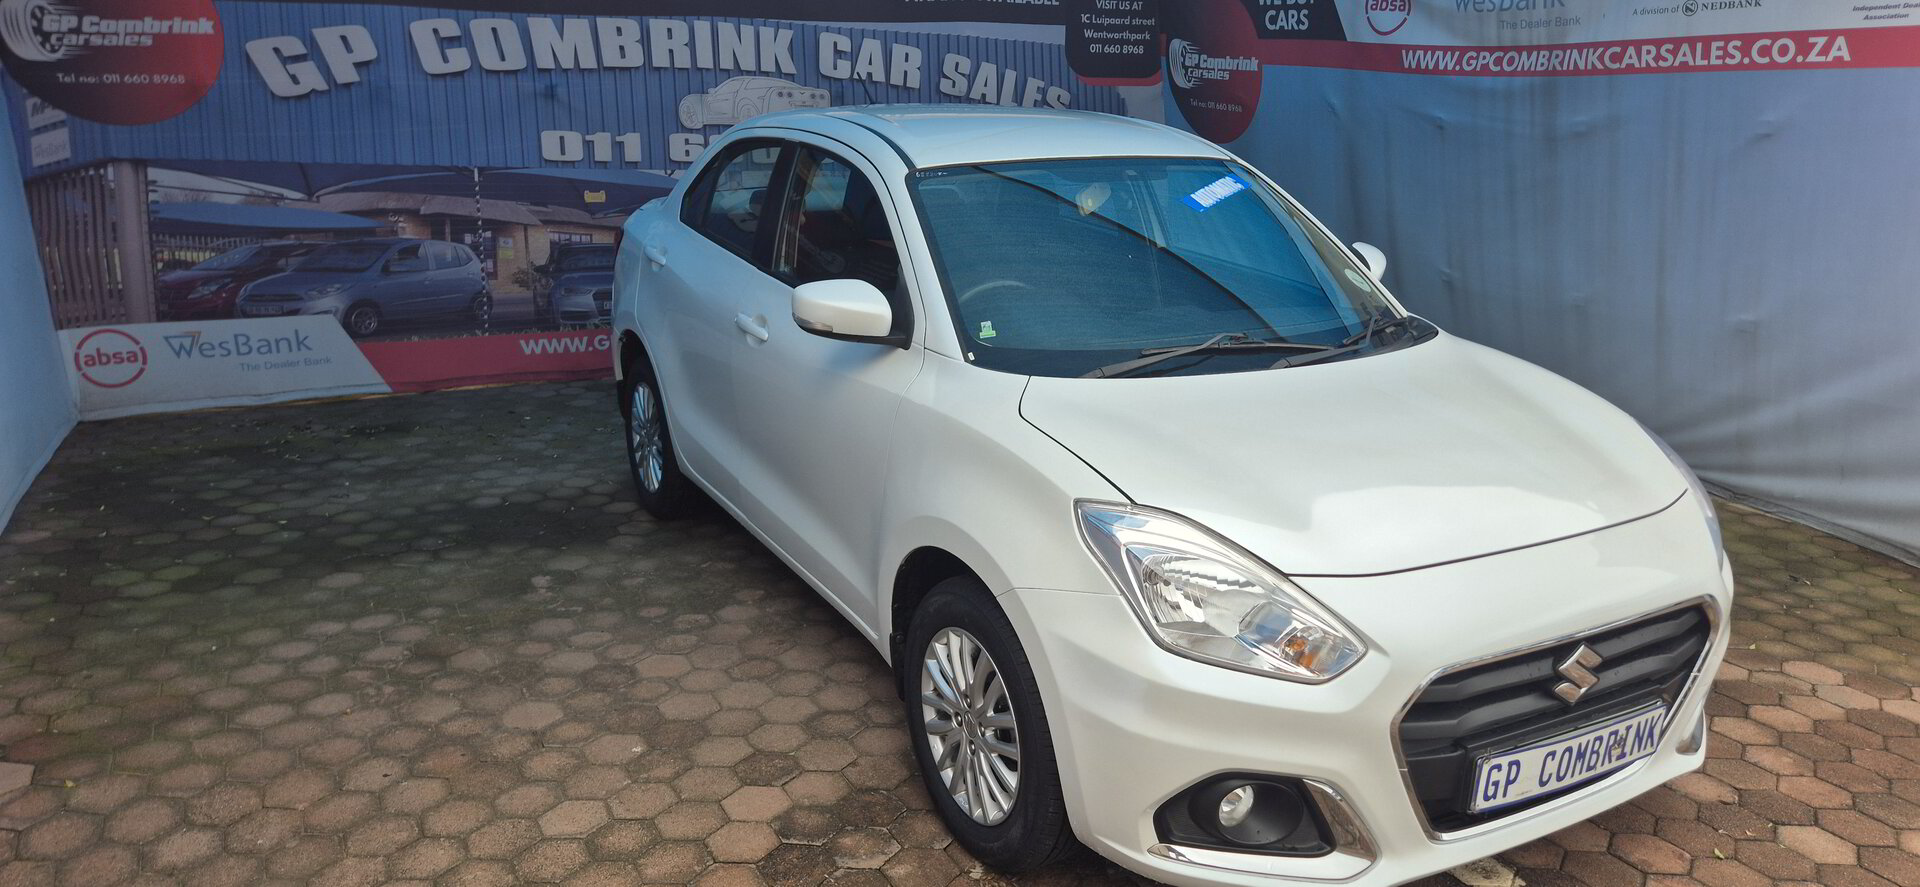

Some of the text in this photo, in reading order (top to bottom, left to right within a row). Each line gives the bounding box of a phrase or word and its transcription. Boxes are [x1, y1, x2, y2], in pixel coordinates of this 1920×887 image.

[1096, 0, 1143, 10] VISIT US AT
[1640, 7, 1669, 16] division
[1671, 5, 1679, 13] of
[1701, 0, 1762, 11] NEDBANK
[1853, 3, 1901, 11] Independent
[42, 15, 214, 35] GP Combrink
[1092, 14, 1130, 26] Luipaard
[1132, 18, 1155, 26] street
[1265, 9, 1309, 30] CARS
[1500, 16, 1581, 30] The Dealer Bank
[50, 33, 153, 46] carsales
[1084, 29, 1150, 41] Wentworthpark
[1090, 44, 1144, 54] 011 660 8968
[1402, 35, 1851, 72] WWW.GPCOMBRINKCARSALES.CO.ZA
[245, 17, 1071, 109] GP COMBRINK CAR SALES
[1200, 54, 1258, 71] Combrink
[56, 72, 75, 83] Tel
[103, 73, 120, 83] 011
[124, 73, 149, 84] 660
[153, 74, 185, 84] 8968
[1188, 68, 1229, 80] carsales
[541, 130, 641, 162] 011
[163, 329, 313, 360] WesBank
[83, 347, 139, 368] absa
[264, 359, 300, 370] Dealer
[1483, 713, 1662, 801] GP COMBRINK
